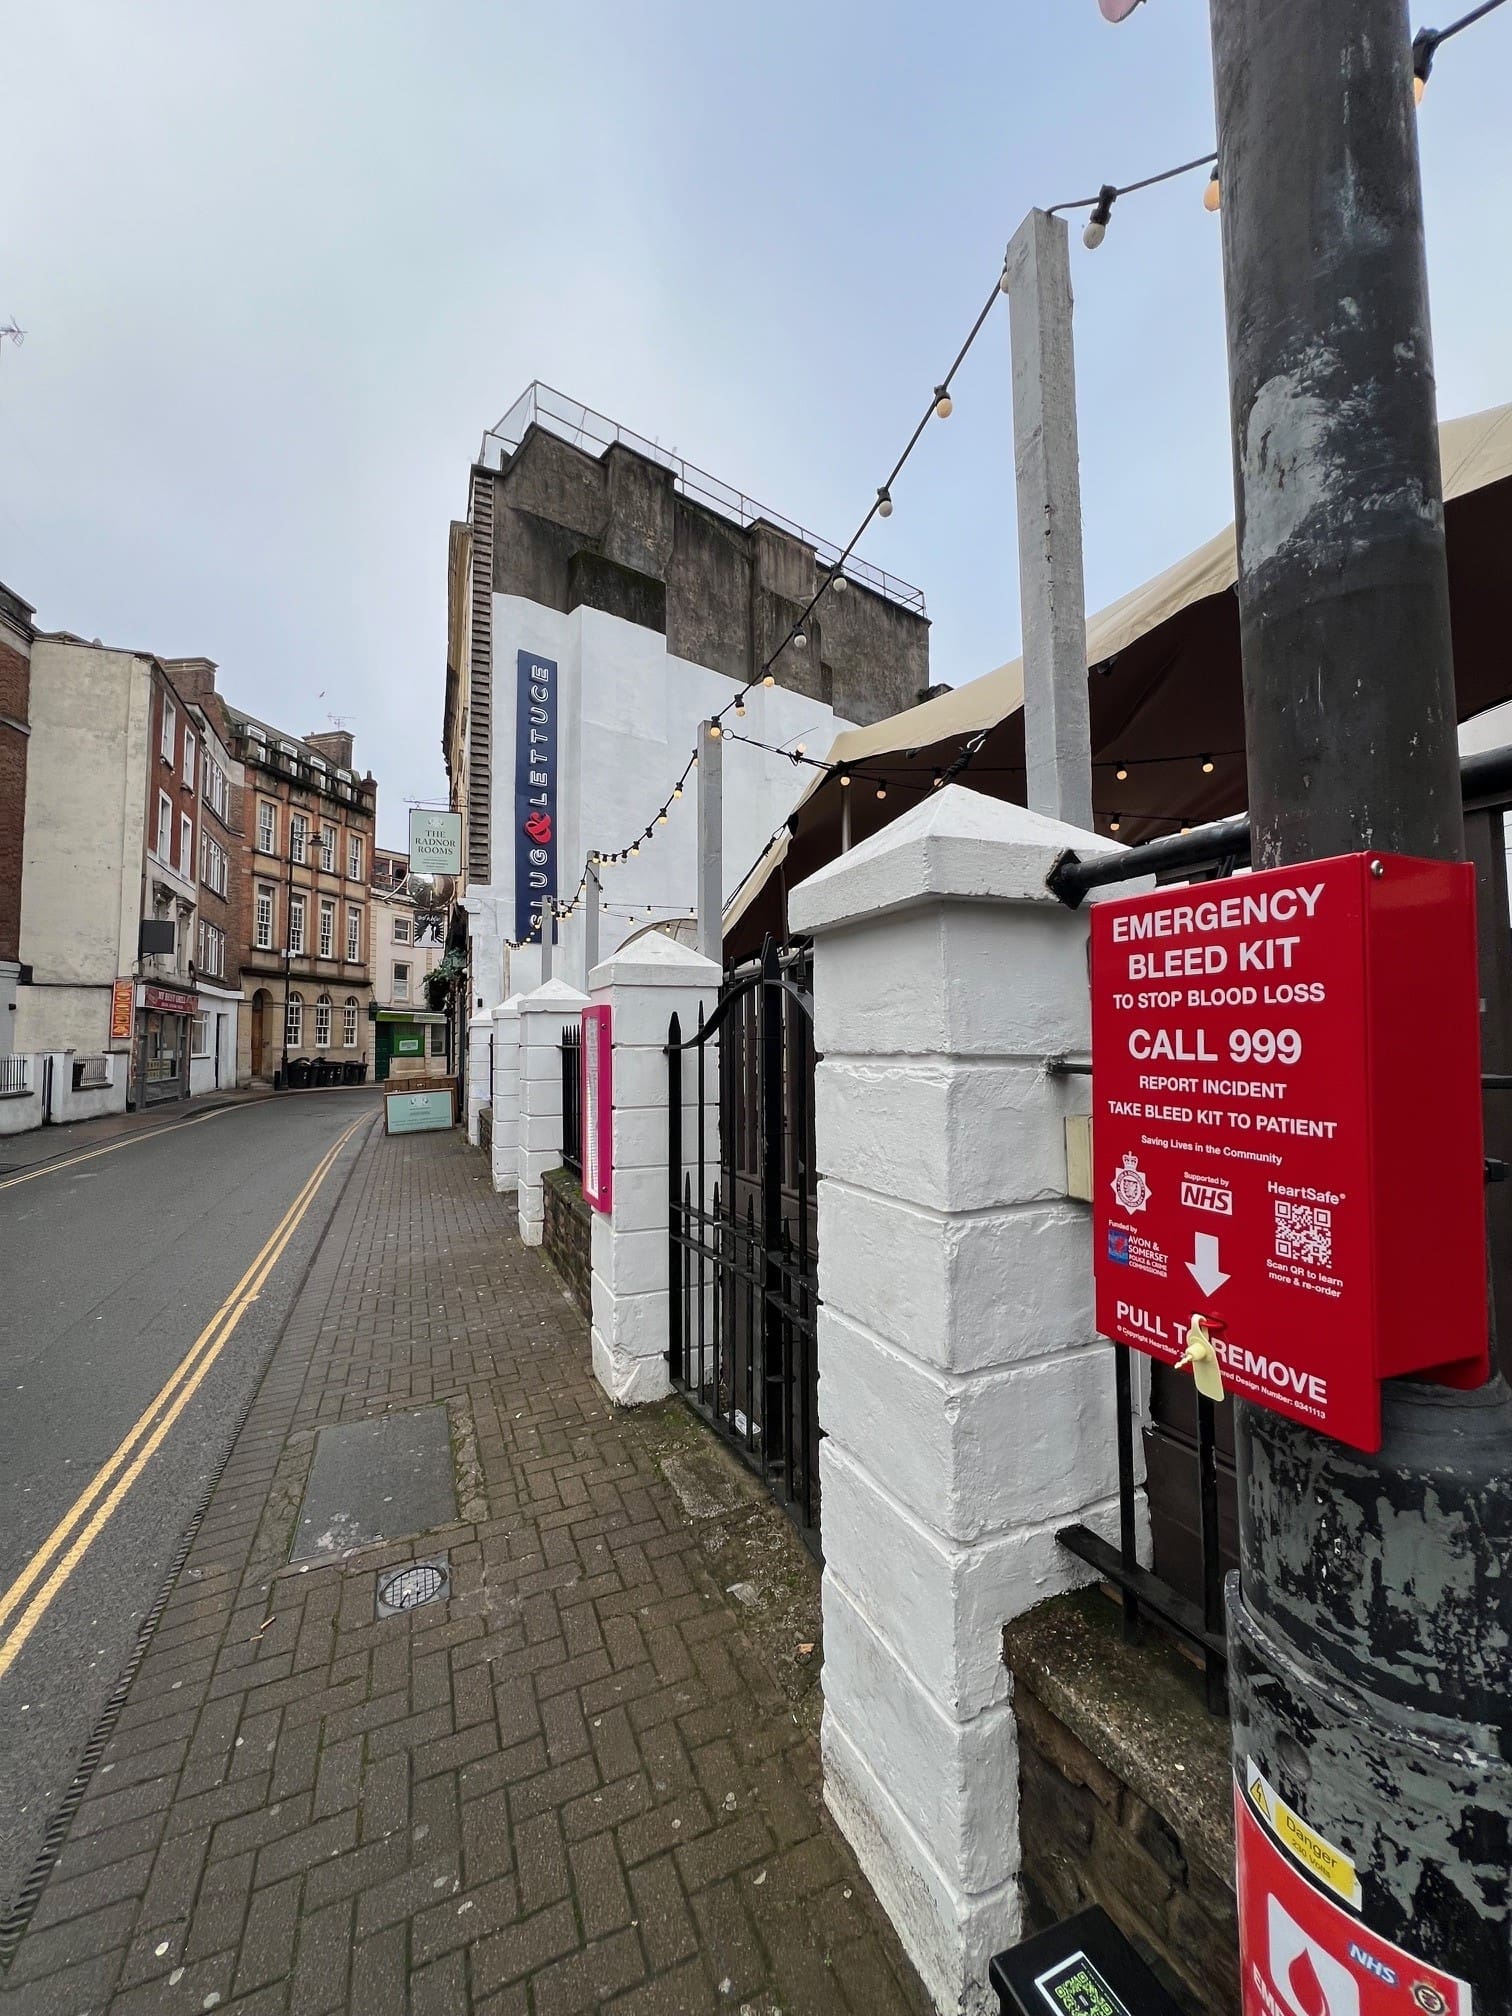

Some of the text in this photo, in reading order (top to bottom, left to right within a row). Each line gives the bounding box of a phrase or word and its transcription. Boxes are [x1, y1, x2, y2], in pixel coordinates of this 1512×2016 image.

[529, 664, 550, 806] LETTUCE
[415, 837, 456, 848] RADNOR
[425, 829, 447, 838] THE
[525, 811, 552, 845] &
[418, 845, 453, 856] ROOMS
[1112, 883, 1326, 943] EMERGENCY
[1128, 936, 1301, 981] BLEED KIT
[1113, 982, 1326, 1010] TO STOP BLOOD LOSS
[1128, 1028, 1302, 1065] CALL 999
[1139, 1075, 1287, 1100] REPORT INCIDENT
[1108, 1101, 1338, 1139] TAKE BLEED KIT TO PATIENT
[1141, 1134, 1283, 1166] Saving Lives in the Community
[1183, 1171, 1230, 1188] Supported by
[1183, 1184, 1231, 1212] NHS
[1128, 1235, 1160, 1252] AVON &
[1128, 1244, 1168, 1264] SOMERSET
[1266, 1258, 1344, 1288] Scan QR to learn
[1268, 1272, 1342, 1298] more & re-order
[1122, 1326, 1149, 1343] Copyright
[1116, 1300, 1169, 1339] PULL
[1211, 1336, 1328, 1404] REMOVE
[1235, 1374, 1260, 1392] Design
[1260, 1384, 1294, 1406] Number:
[1286, 1815, 1338, 1868] Danger
[1291, 1838, 1331, 1879] 230 Volts
[1349, 1943, 1397, 1986] NHS
